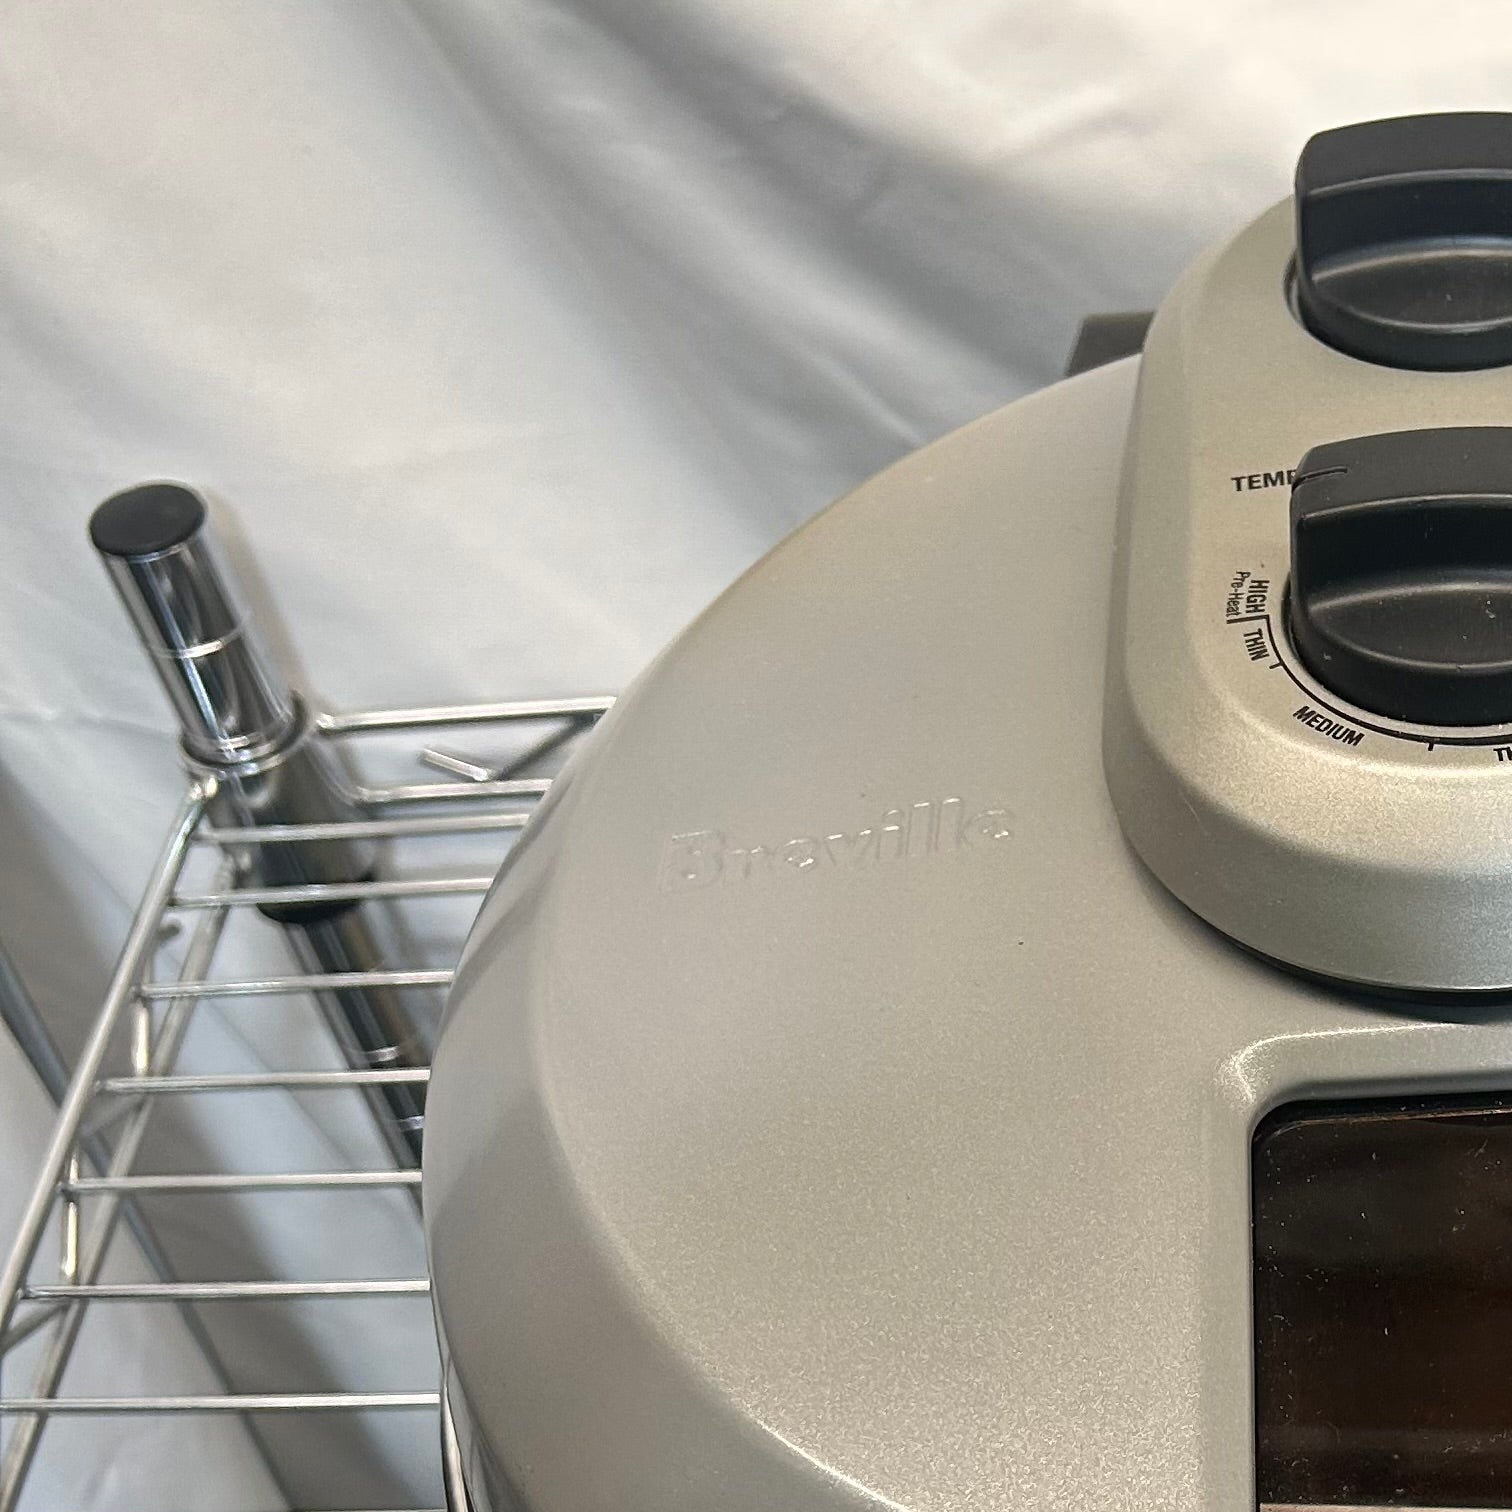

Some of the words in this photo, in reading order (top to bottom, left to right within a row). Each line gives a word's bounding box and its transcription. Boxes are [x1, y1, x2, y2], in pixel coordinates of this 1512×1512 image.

[1225, 571, 1251, 617] Pre-Heat
[1245, 580, 1270, 613] HIGH
[1243, 628, 1270, 661] THIN
[1293, 705, 1365, 747] MEDIUM
